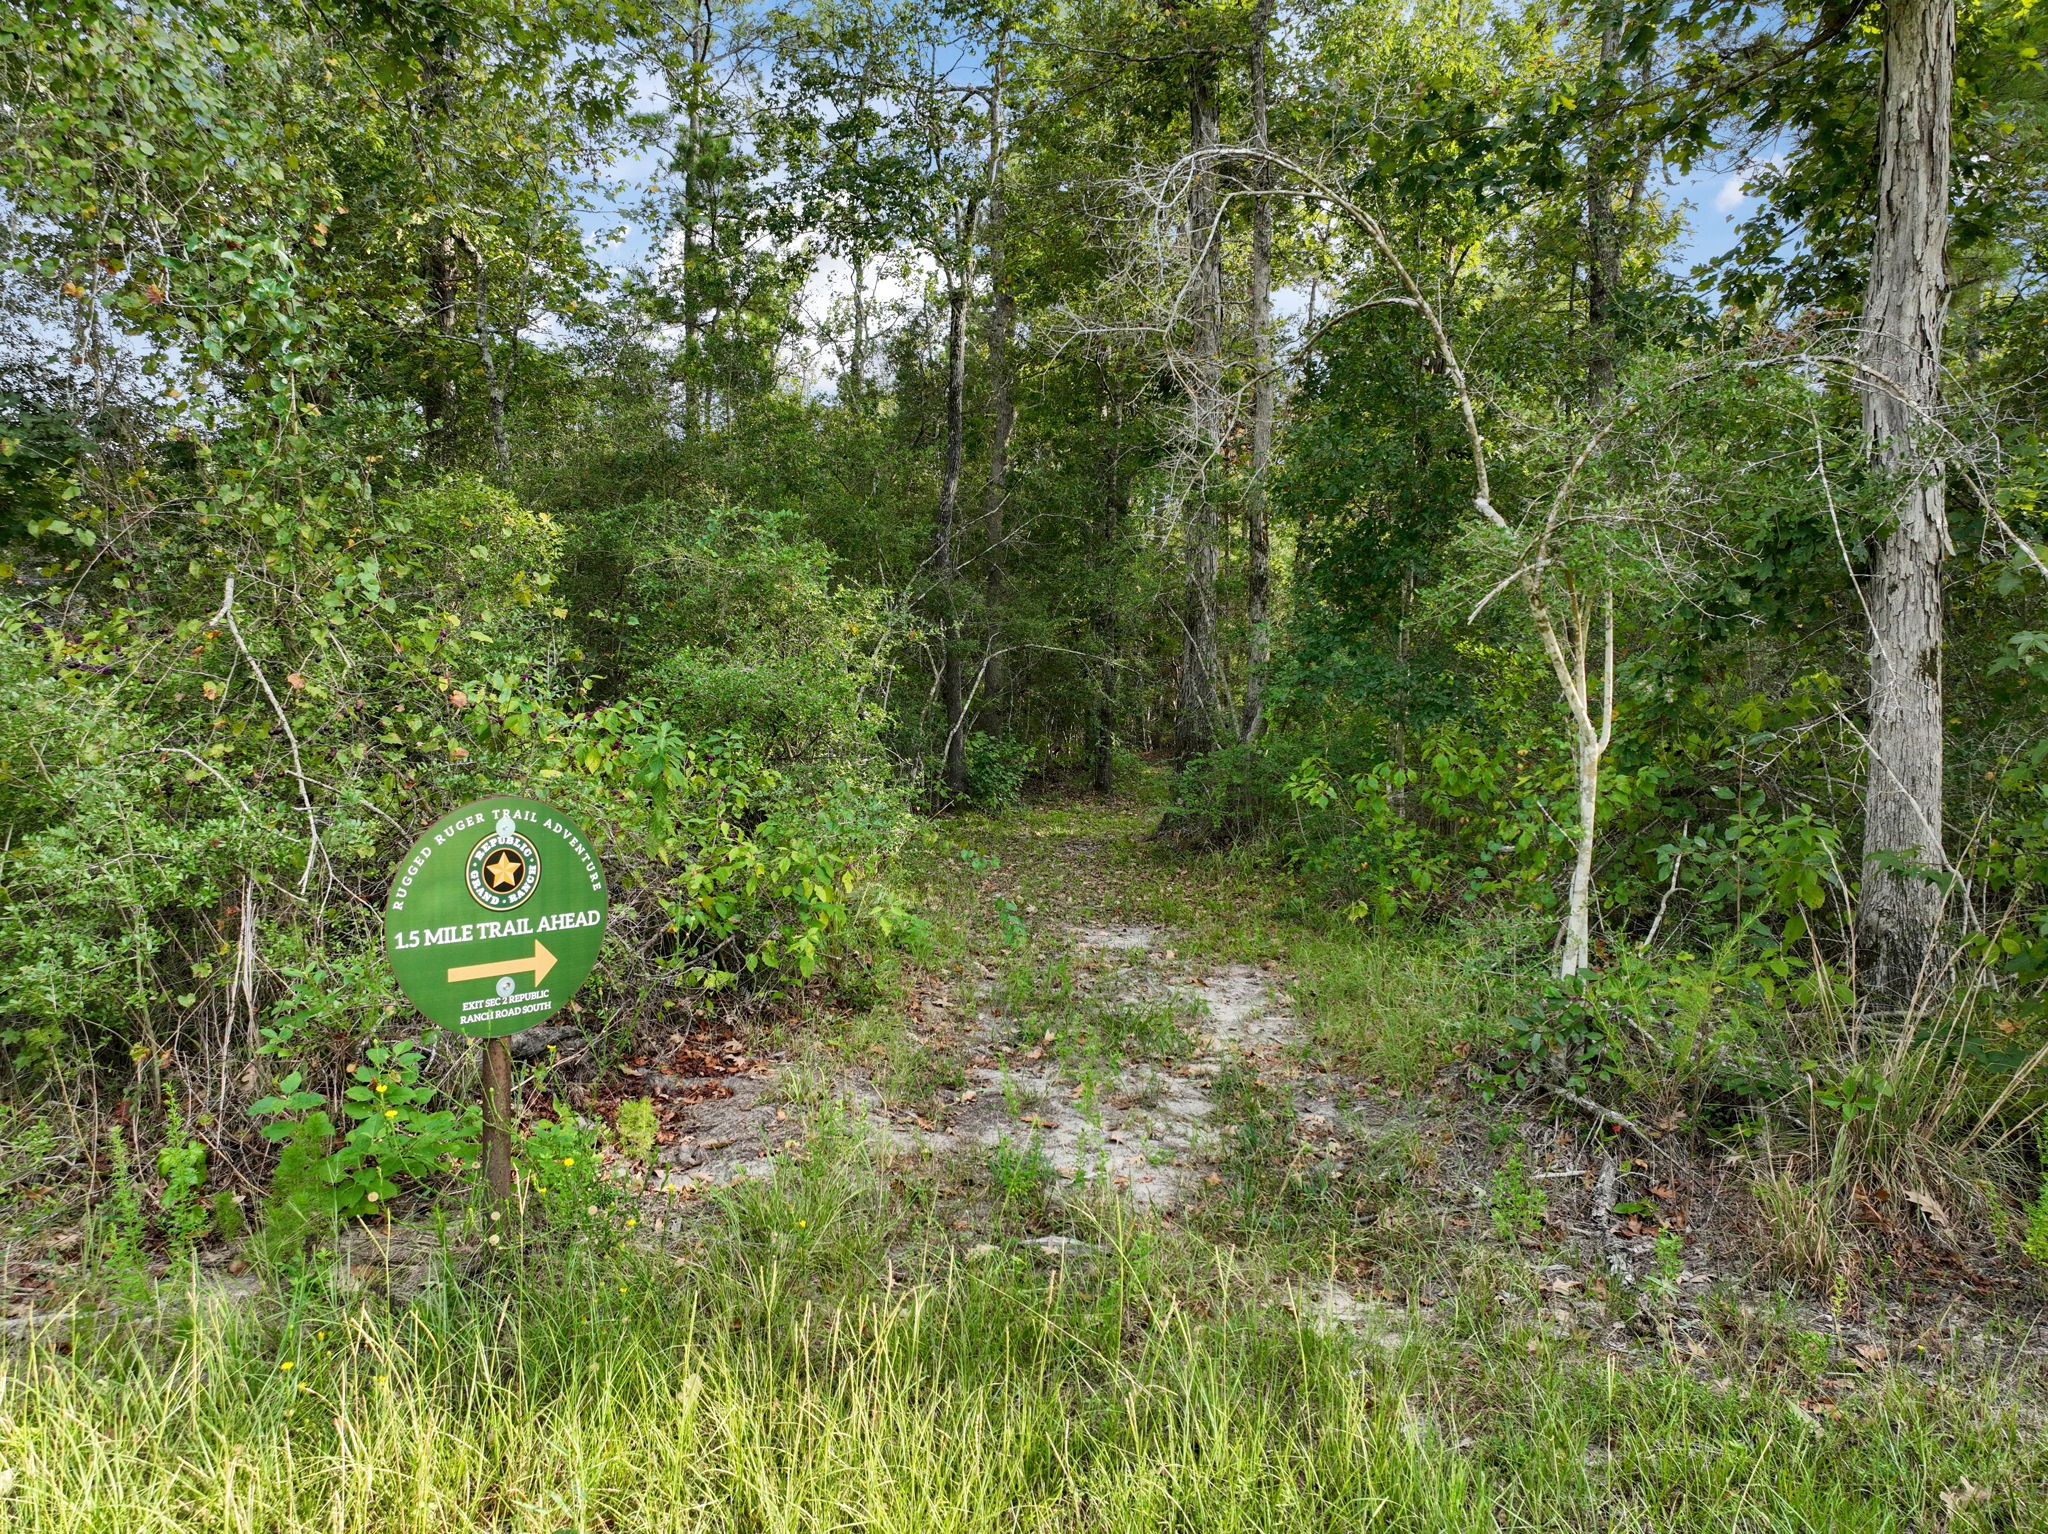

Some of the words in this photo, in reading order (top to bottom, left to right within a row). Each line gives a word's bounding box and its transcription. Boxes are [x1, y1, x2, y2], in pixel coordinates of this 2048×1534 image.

[392, 846, 432, 910] RUGGED
[434, 812, 485, 845] RUGER
[492, 809, 537, 822] TRAIL
[543, 820, 602, 892] ADVENTURE
[474, 836, 532, 860] REPUBLIC
[470, 870, 500, 905] GRAND
[508, 865, 537, 903] RANCH
[394, 930, 420, 950] 1.5
[424, 925, 473, 946] MILE
[477, 918, 533, 939] TRAIL
[537, 910, 600, 932] AHEAD
[460, 1011, 494, 1024] RANCH
[495, 1006, 522, 1019] ROAD
[522, 1001, 551, 1013] SOUTH
[463, 1000, 484, 1011] EXIT
[485, 997, 502, 1008] SEC
[502, 995, 508, 1005] 2
[508, 990, 549, 1004] REPUBLIC
